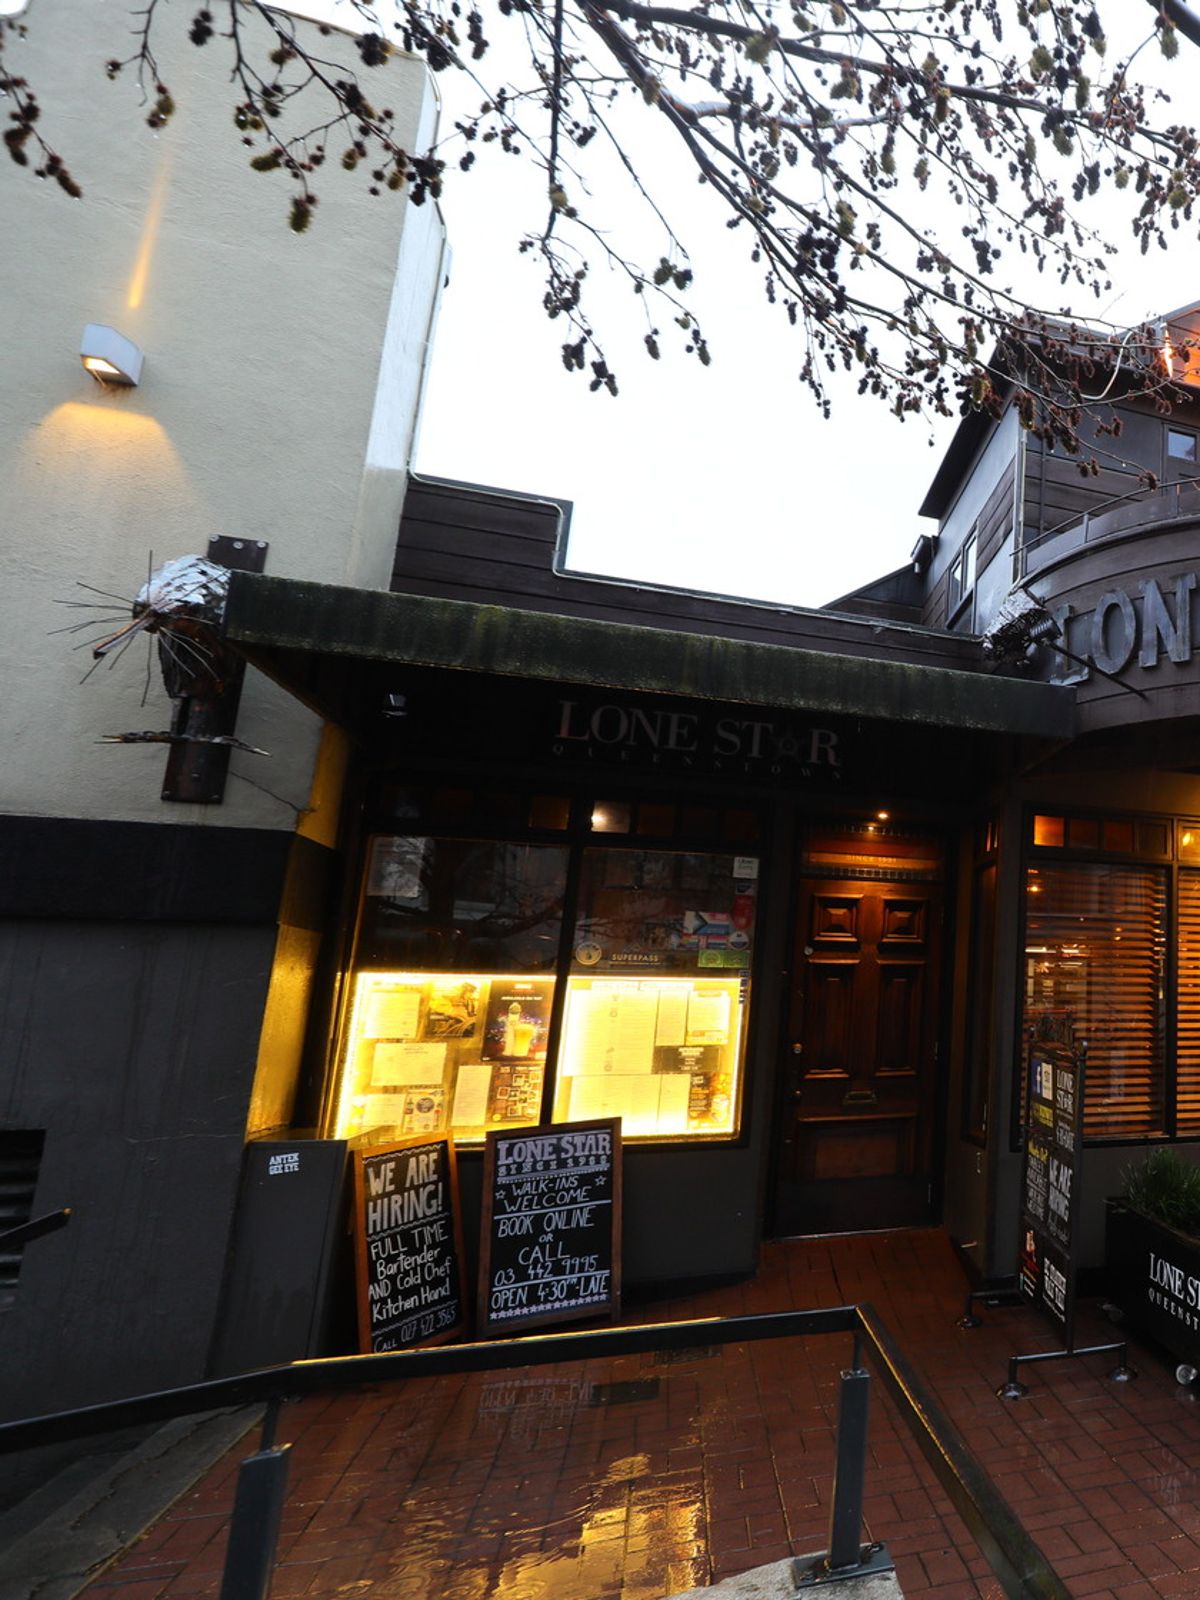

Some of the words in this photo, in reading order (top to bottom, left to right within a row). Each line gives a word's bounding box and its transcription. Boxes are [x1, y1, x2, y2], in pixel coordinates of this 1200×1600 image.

[554, 700, 699, 752] LONE
[612, 953, 659, 962] SUPERPASS
[497, 1139, 558, 1165] LONE
[560, 1133, 612, 1158] STAR
[368, 1161, 396, 1197] WE
[405, 1152, 438, 1188] ARE
[512, 1175, 580, 1197] WALK-INS
[368, 1182, 443, 1234] HIRING!
[504, 1185, 592, 1213] WELCOME
[498, 1215, 534, 1238] BOOK
[543, 1205, 596, 1232] ONLINE
[539, 1232, 554, 1243] OR
[371, 1234, 408, 1261] FULL
[411, 1220, 449, 1248] TIME
[518, 1241, 571, 1265] CALL
[368, 1279, 391, 1301] AND
[397, 1266, 421, 1290] Cold
[424, 1256, 453, 1281] Chef
[377, 1244, 441, 1280] Bartender
[494, 1268, 515, 1287] 03
[527, 1262, 554, 1280] 442
[561, 1254, 599, 1275] 9995
[1149, 1252, 1185, 1300] LONE
[373, 1295, 419, 1323] Kitchen
[420, 1277, 450, 1305] Hand
[491, 1286, 528, 1310] OPEN
